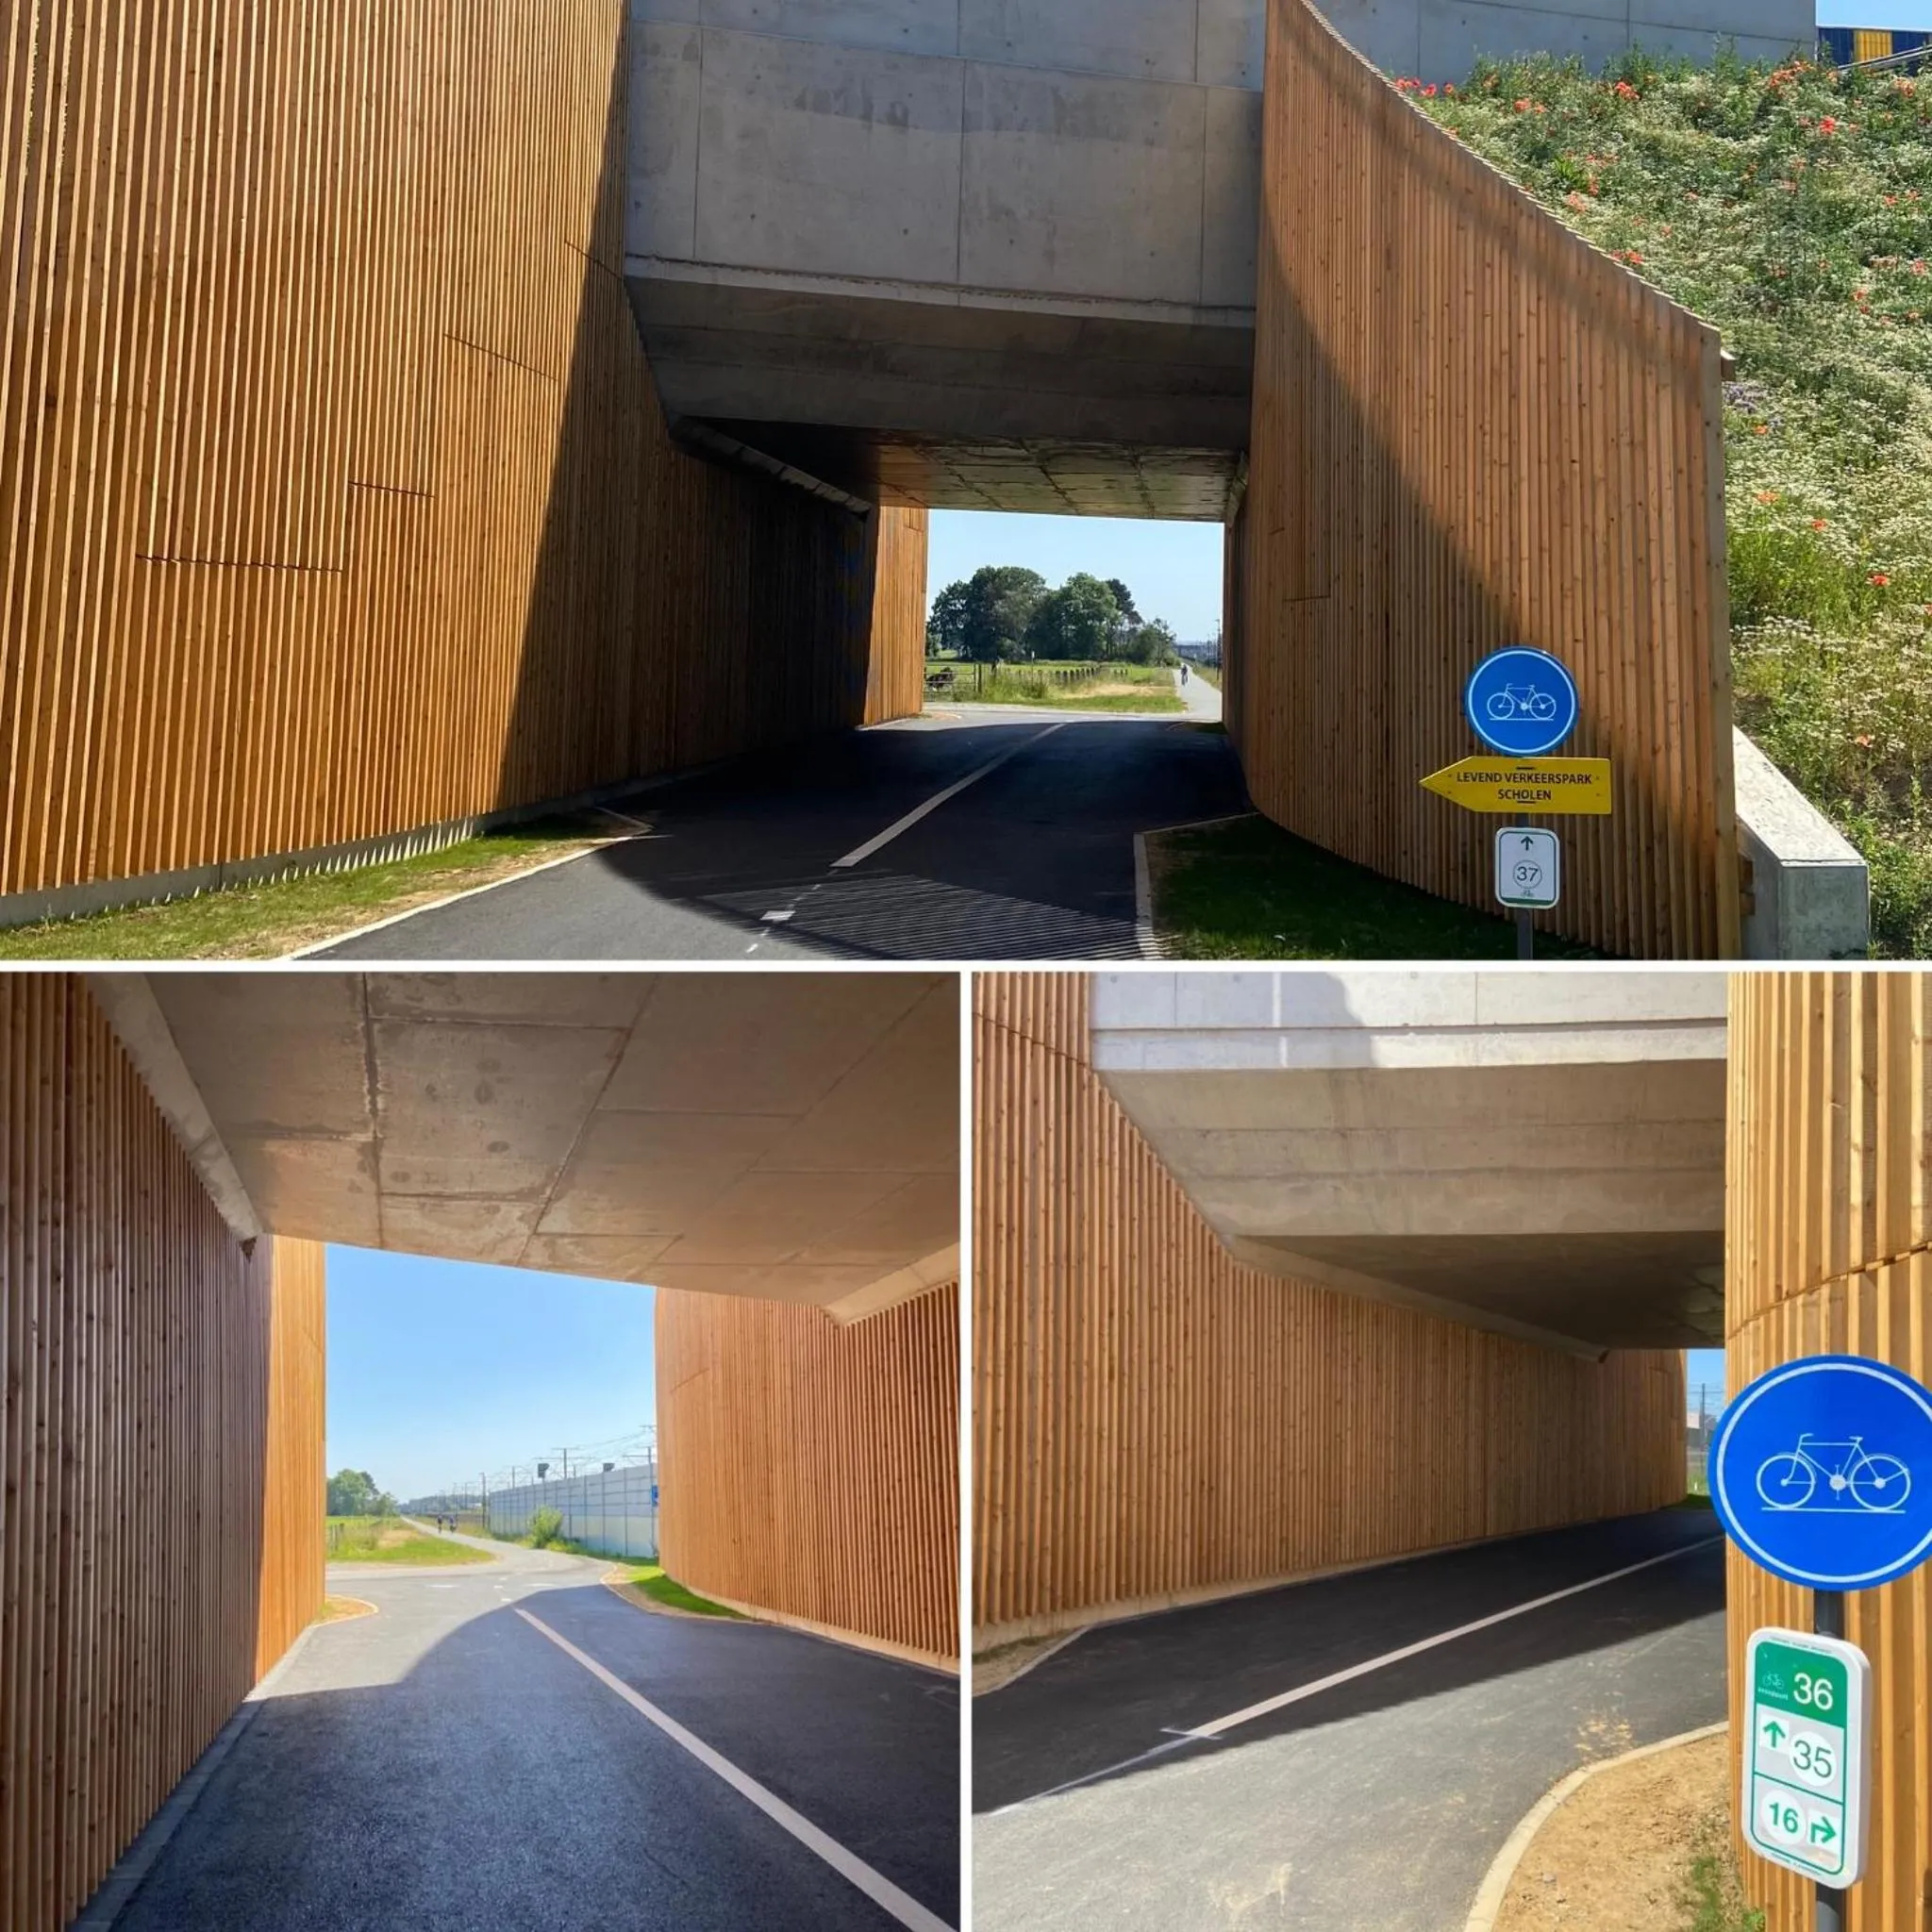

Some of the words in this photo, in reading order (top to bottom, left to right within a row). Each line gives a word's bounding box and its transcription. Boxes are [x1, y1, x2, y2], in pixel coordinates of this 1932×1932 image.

[1457, 772, 1503, 783] LEVEND
[1505, 773, 1592, 784] VERKEERSPARK
[1498, 789, 1552, 801] SCHOLEN
[1516, 866, 1539, 882] 37
[1793, 1673, 1834, 1710] 36
[1793, 1740, 1832, 1778] 35
[1769, 1802, 1799, 1834] 16
